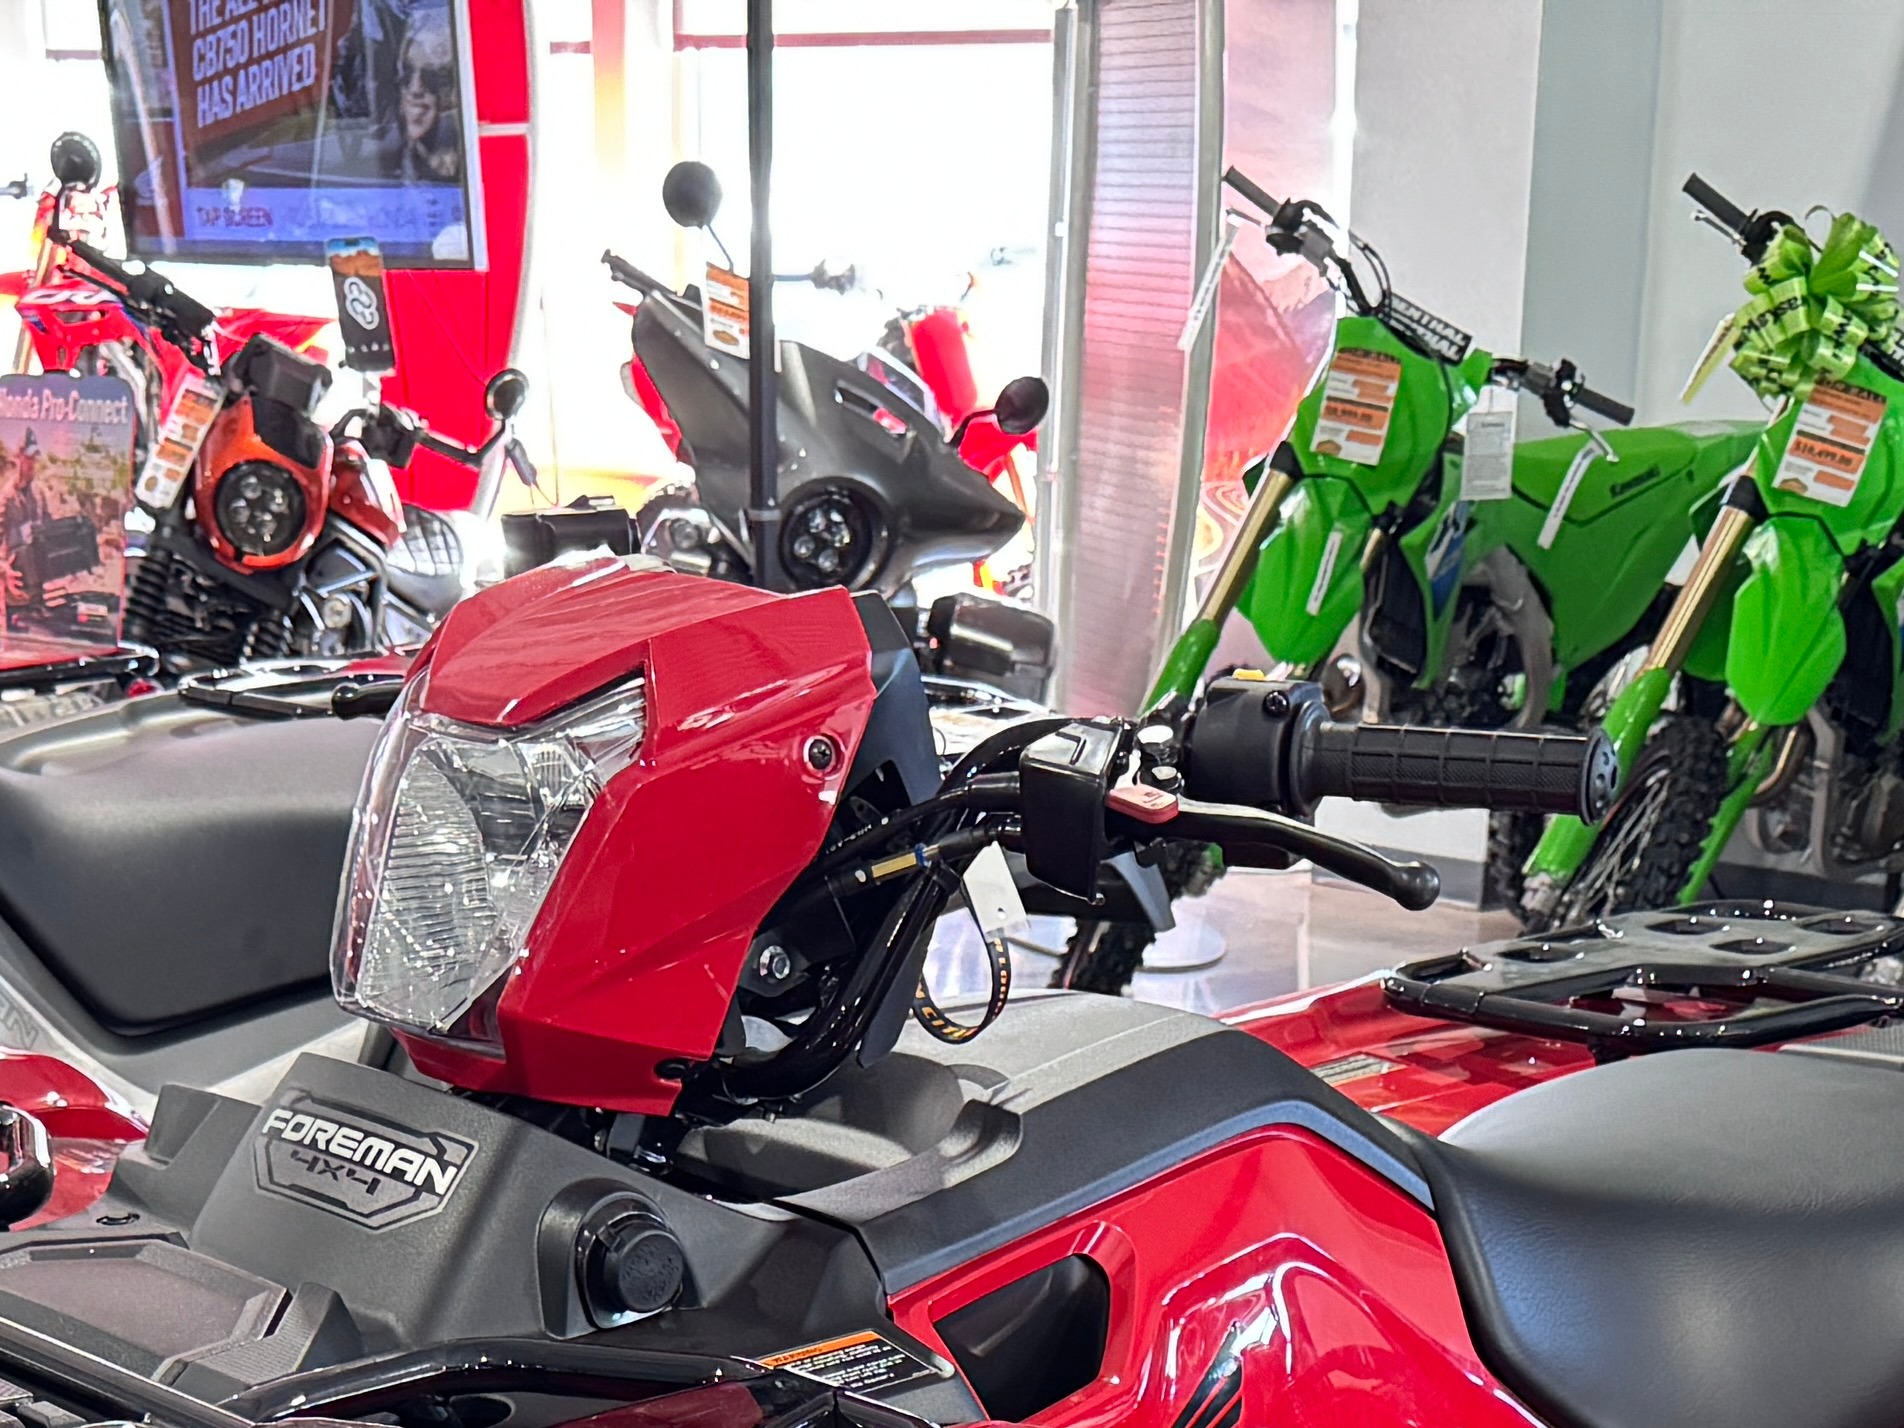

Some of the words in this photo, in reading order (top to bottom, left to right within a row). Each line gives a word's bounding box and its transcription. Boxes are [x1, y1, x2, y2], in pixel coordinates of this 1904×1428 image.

[193, 24, 248, 81] CB750
[253, 0, 327, 59] HORNET
[197, 73, 234, 128] HAS
[236, 42, 317, 114] ARRIVED
[42, 388, 128, 425] Pro-Connect
[261, 1097, 459, 1196] FOREMAN
